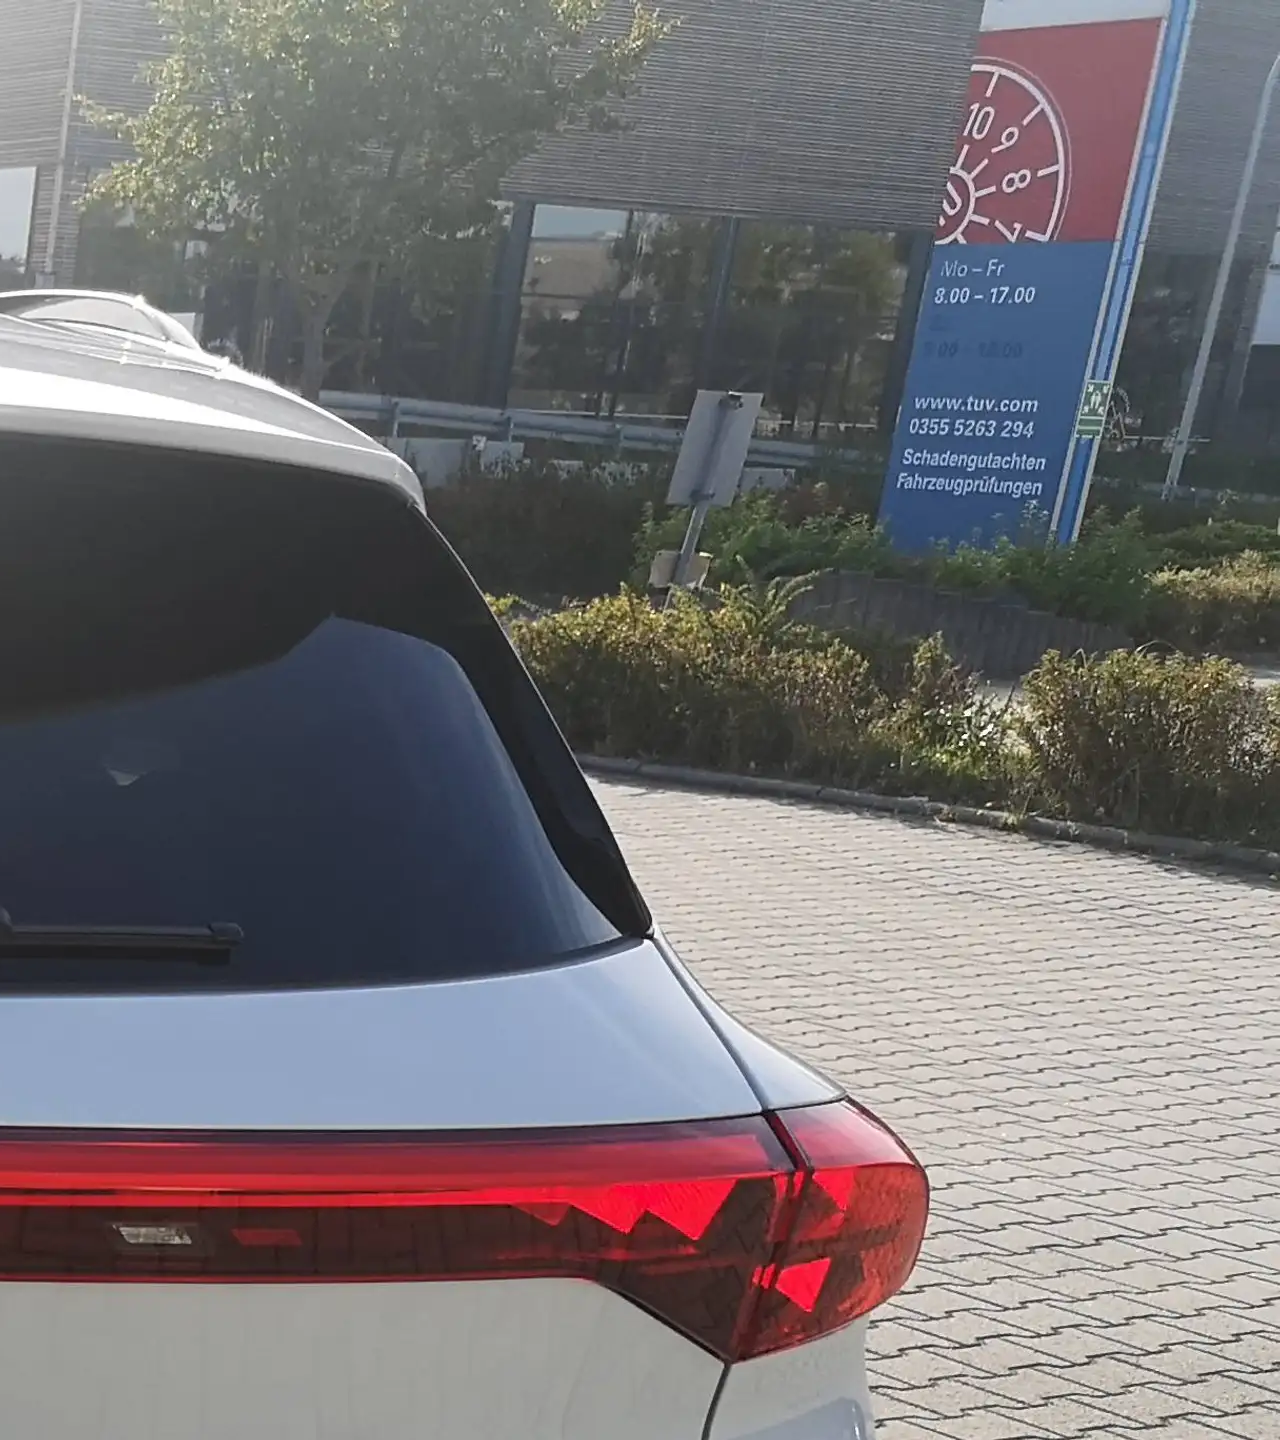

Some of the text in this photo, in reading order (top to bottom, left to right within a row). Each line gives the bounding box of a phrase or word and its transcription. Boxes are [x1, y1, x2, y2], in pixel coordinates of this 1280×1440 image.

[963, 103, 995, 140] 10
[991, 126, 1019, 154] 9
[1002, 168, 1032, 194] 8
[940, 260, 968, 277] Mo
[986, 258, 1005, 277] Fr
[934, 286, 970, 304] 8.00
[990, 286, 1036, 304] 17.00
[914, 395, 1039, 413] www.tuv.com
[909, 418, 1035, 439] 0355 5263 294
[902, 448, 1047, 472] Schadengutachten
[896, 472, 1043, 498] Fahrzeugprüfungen
